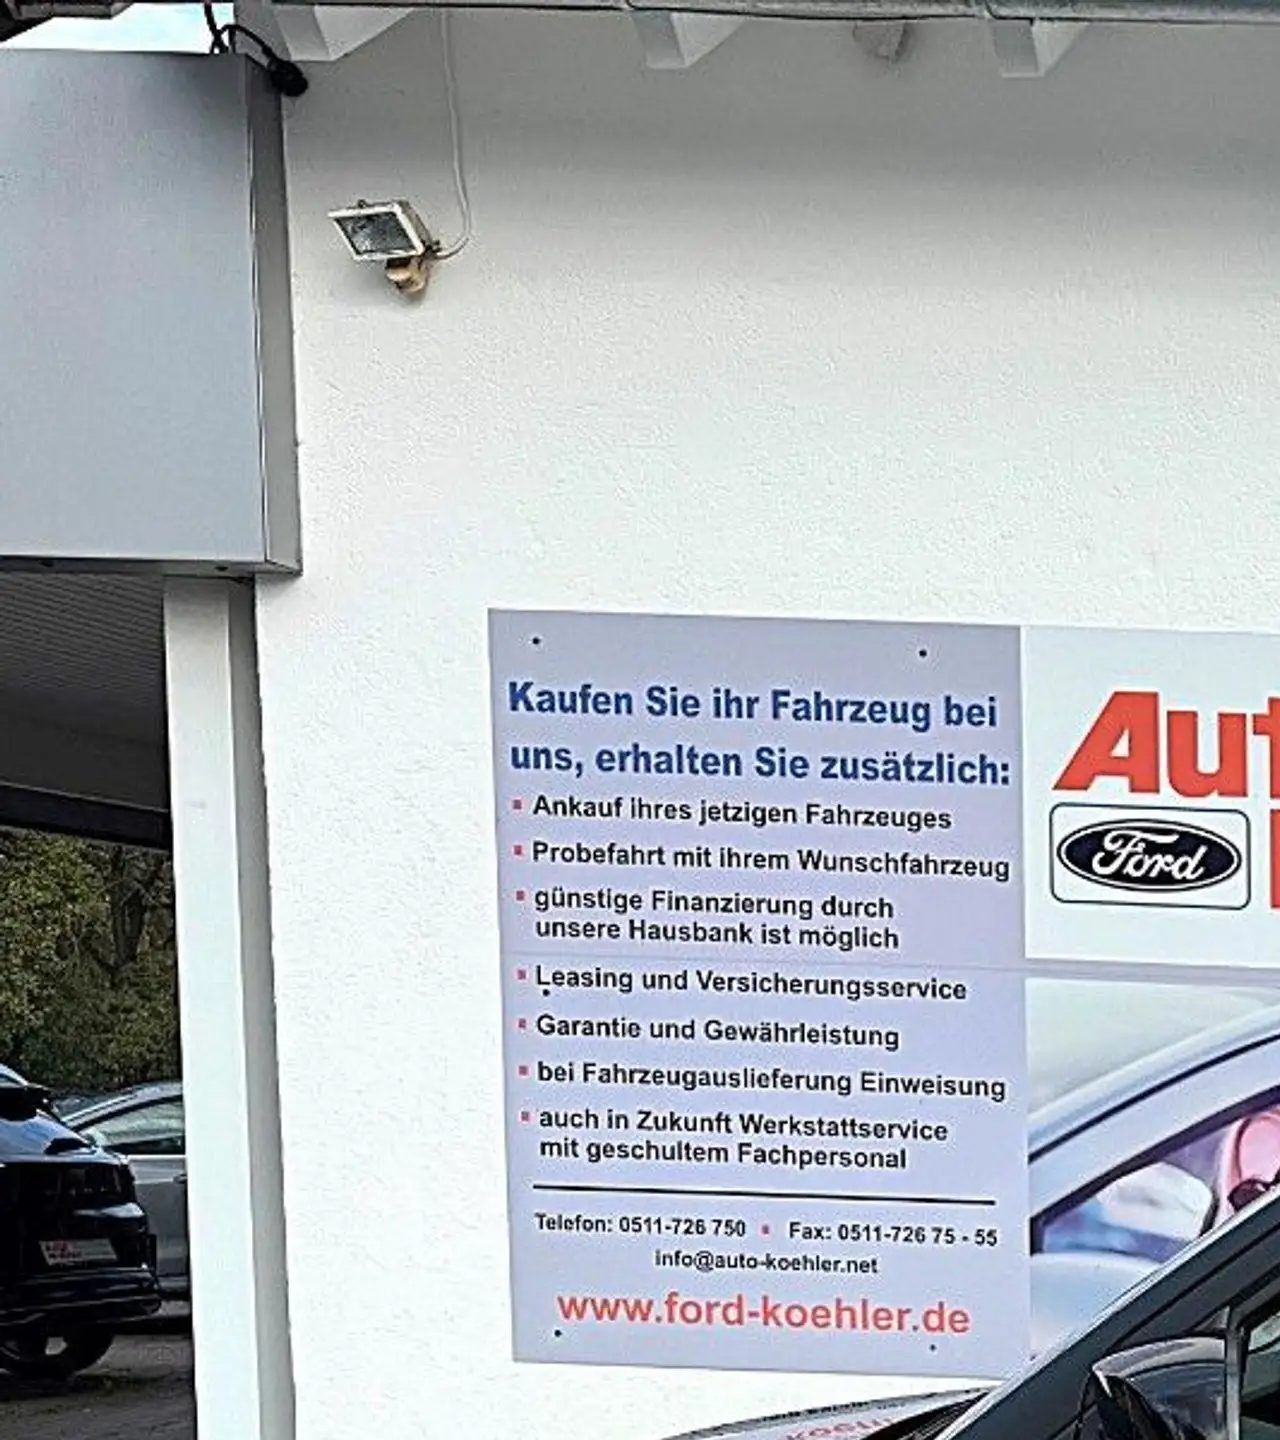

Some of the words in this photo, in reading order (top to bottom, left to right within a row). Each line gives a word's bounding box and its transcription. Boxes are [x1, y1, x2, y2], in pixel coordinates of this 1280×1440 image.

[510, 682, 632, 714] Kaufen
[647, 686, 700, 717] Sie
[714, 688, 759, 718] ihr
[772, 690, 930, 732] Fahrzeug
[945, 696, 996, 726] bei
[512, 747, 582, 778] uns,
[596, 743, 741, 776] erhalten
[756, 747, 809, 778] Sie
[821, 751, 1008, 785] zusätzlich:
[533, 795, 623, 817] Ankauf
[631, 797, 691, 819] ihres
[699, 800, 797, 828] jetzigen
[807, 804, 951, 832] Fahrzeuges
[533, 841, 665, 865] Probefahrt
[674, 847, 711, 867] mit
[720, 848, 789, 869] ihrem
[797, 850, 1009, 882] Wunschfahrzeug
[1092, 828, 1206, 882] Ford
[535, 887, 642, 914] günstige
[653, 891, 812, 920] Finanzierung
[821, 896, 893, 918] durch
[536, 922, 620, 939] unsere
[629, 919, 752, 944] Hausbank
[762, 924, 791, 944] ist
[800, 926, 898, 951] möglich
[537, 965, 632, 993] Leasing
[643, 970, 687, 990] und
[696, 970, 966, 1001] Versicherungsservice
[537, 1014, 641, 1038] Garantie
[650, 1020, 694, 1039] und
[705, 1020, 898, 1052] Gewährleistung
[538, 1061, 573, 1081] bei
[583, 1063, 851, 1096] Fahrzeugauslieferung
[862, 1072, 1004, 1102] Einweisung
[540, 1108, 598, 1129] auch
[608, 1109, 628, 1129] in
[637, 1110, 732, 1133] Zukunft
[739, 1114, 947, 1140] Werkstattservice
[541, 1139, 579, 1157] mit
[586, 1140, 728, 1163] geschultem
[738, 1143, 905, 1170] Fachpersonal
[535, 1213, 612, 1232] Telefon:
[620, 1217, 706, 1235] 0511-726
[712, 1219, 745, 1237] 750
[790, 1222, 831, 1239] Fax:
[838, 1224, 925, 1243] 0511-726
[932, 1227, 955, 1244] 75
[975, 1229, 997, 1246] 55
[656, 1250, 877, 1273] info@auto-koehler.net
[557, 1293, 970, 1334] www.ford-koehler.de
